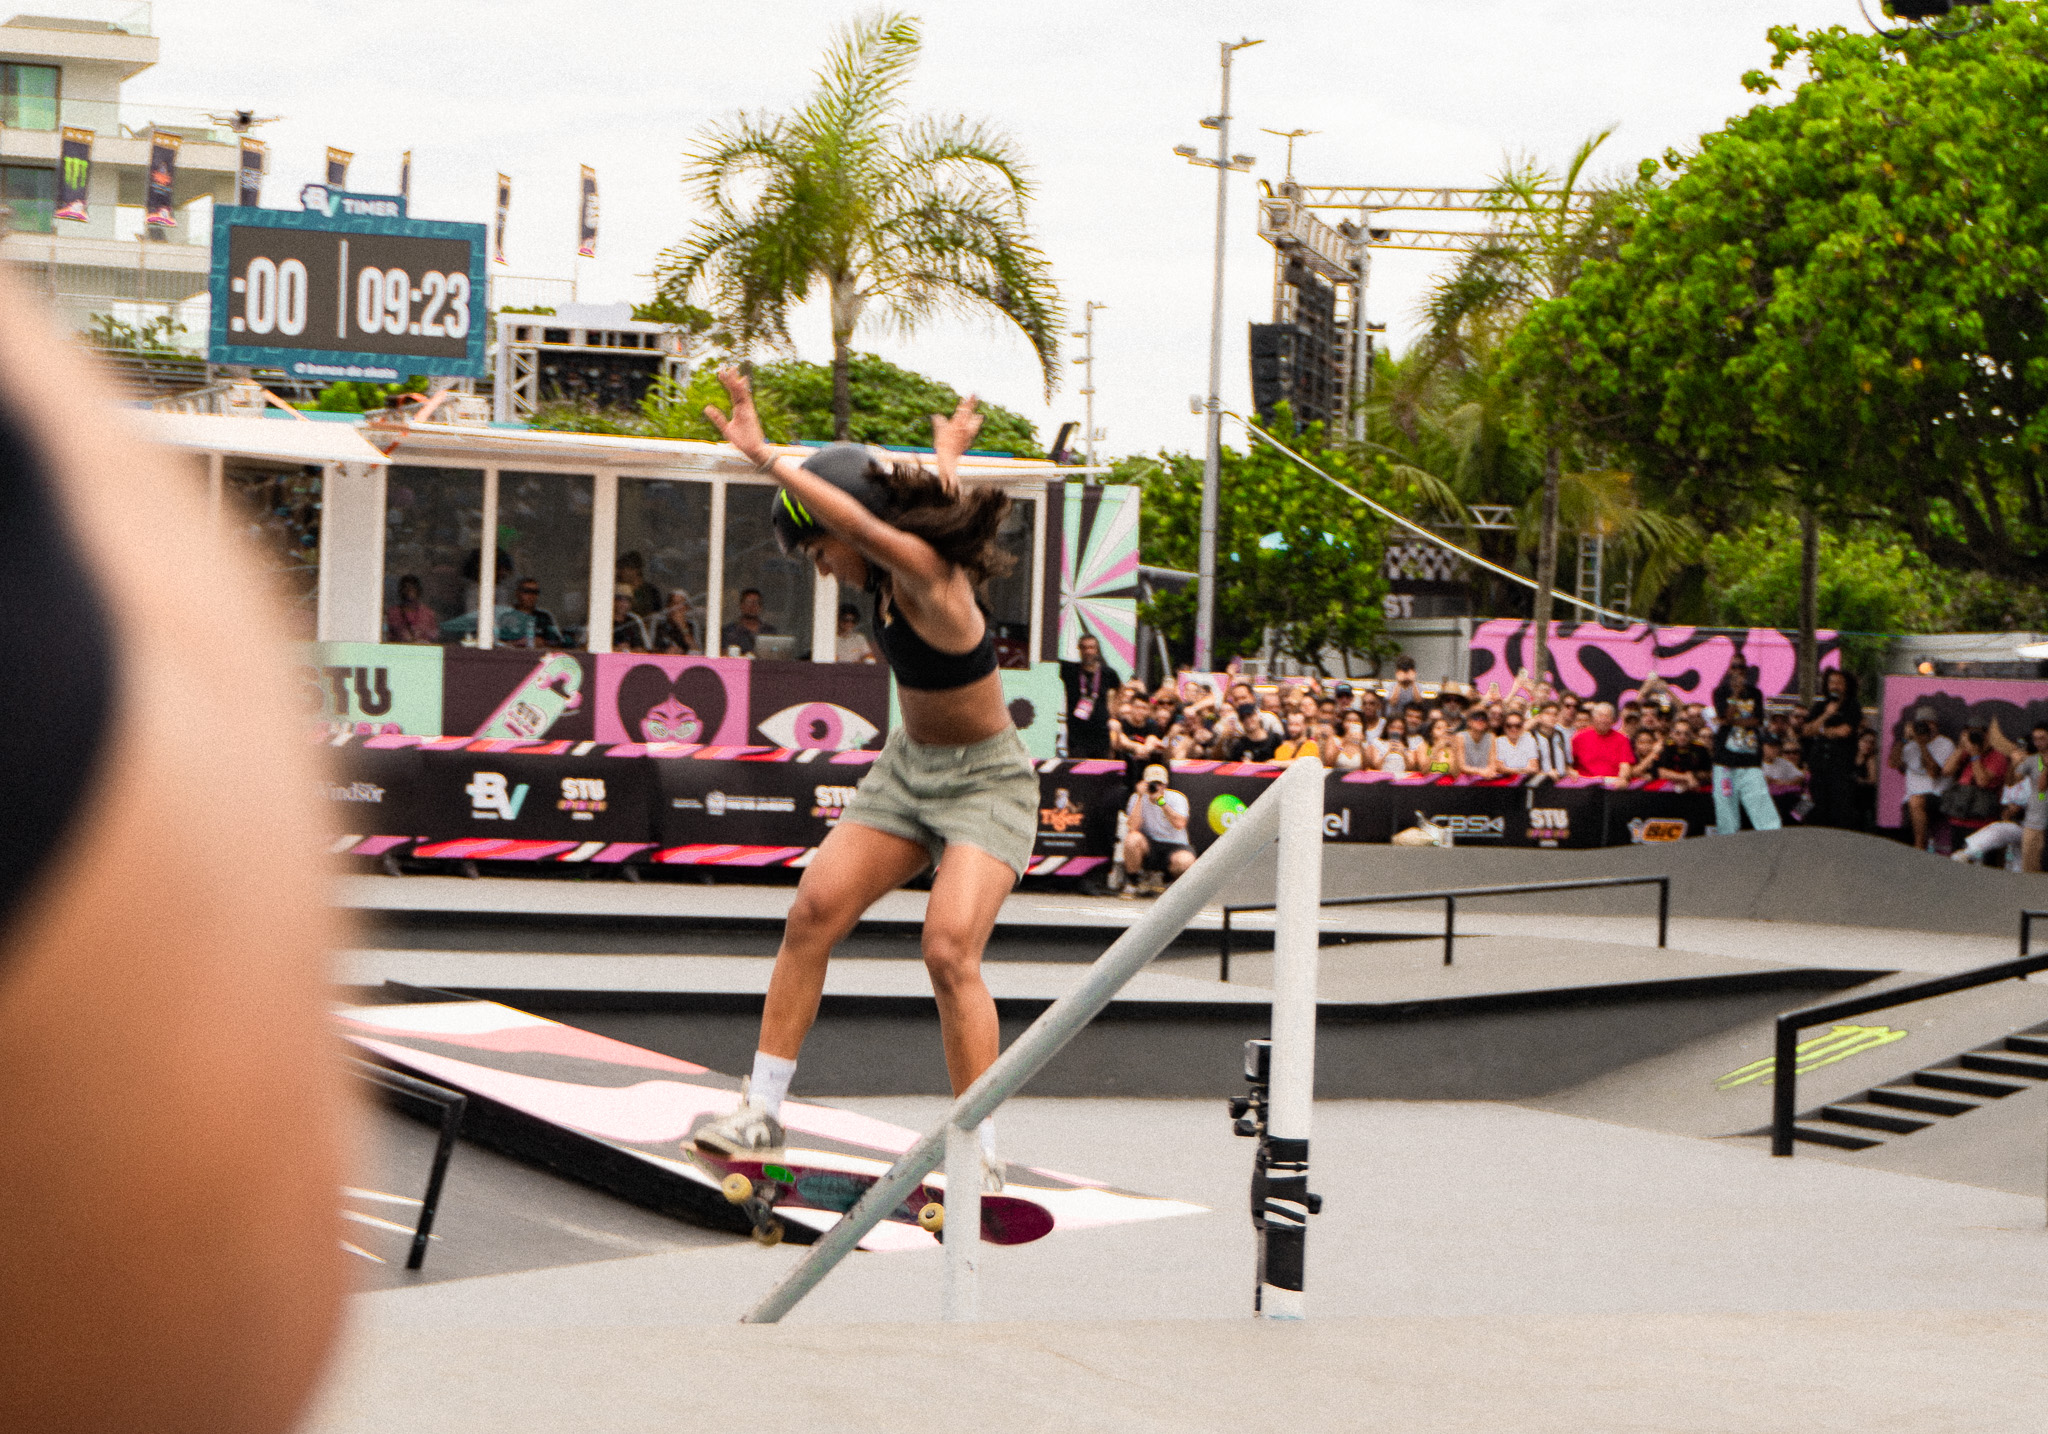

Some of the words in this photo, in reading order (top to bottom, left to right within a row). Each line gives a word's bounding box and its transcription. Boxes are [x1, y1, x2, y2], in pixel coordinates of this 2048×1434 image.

[341, 199, 400, 218] TIMER
[356, 266, 470, 339] 09:23
[317, 781, 387, 803] indsor
[560, 777, 607, 801] STU
[1040, 808, 1084, 832] Tiger
[1529, 807, 1569, 829] STU
[1645, 825, 1682, 840] BIC
